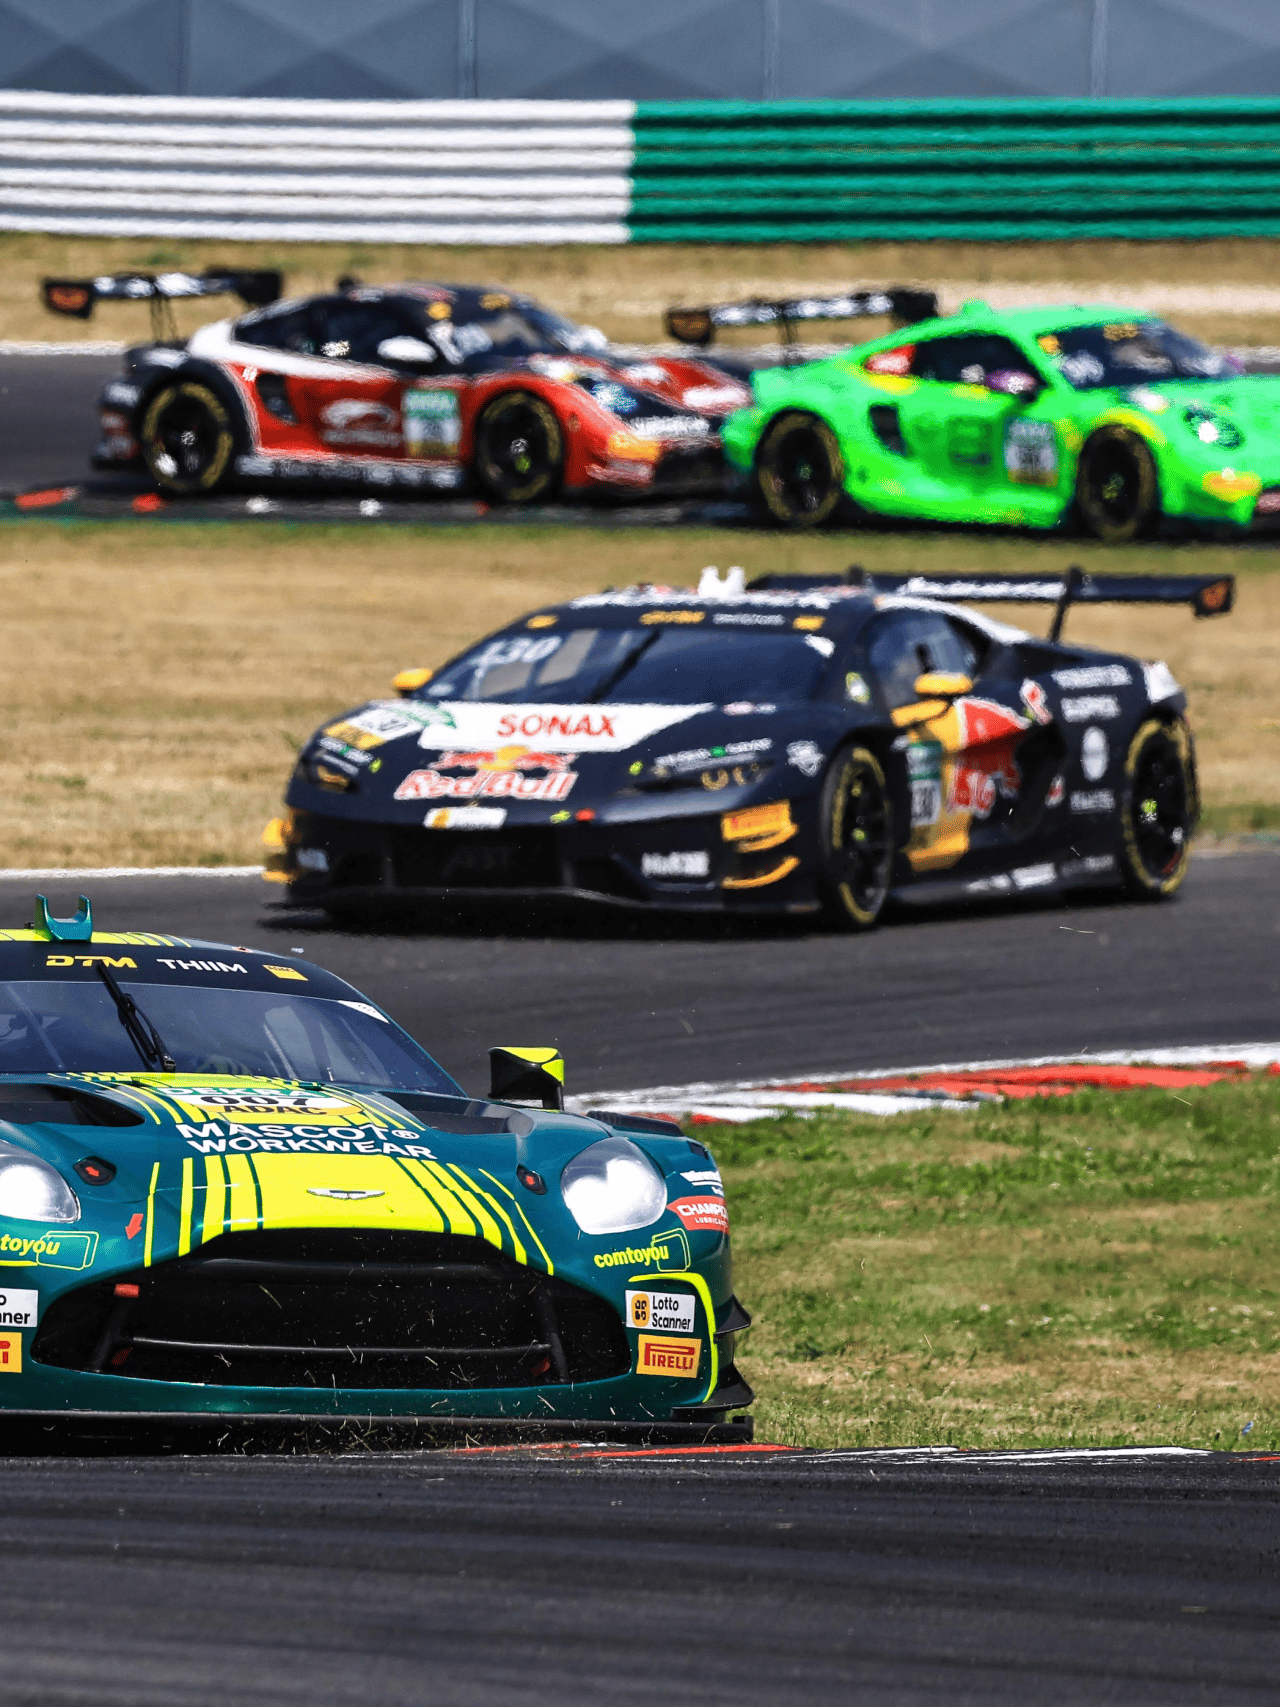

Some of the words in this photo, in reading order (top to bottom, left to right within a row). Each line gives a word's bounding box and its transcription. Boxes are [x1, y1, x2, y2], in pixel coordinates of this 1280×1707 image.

[496, 713, 617, 738] SONAX
[46, 955, 138, 969] DTM
[157, 958, 248, 974] THIIM
[163, 1087, 315, 1097] DEKRA
[200, 1096, 311, 1106] 007
[223, 1104, 328, 1116] ADAC
[188, 1136, 438, 1160] WORKWEAR
[593, 1245, 669, 1268] comtoyou
[652, 1295, 679, 1312] Lotto
[651, 1312, 692, 1331] Scanner
[643, 1342, 696, 1370] PIRELLI
